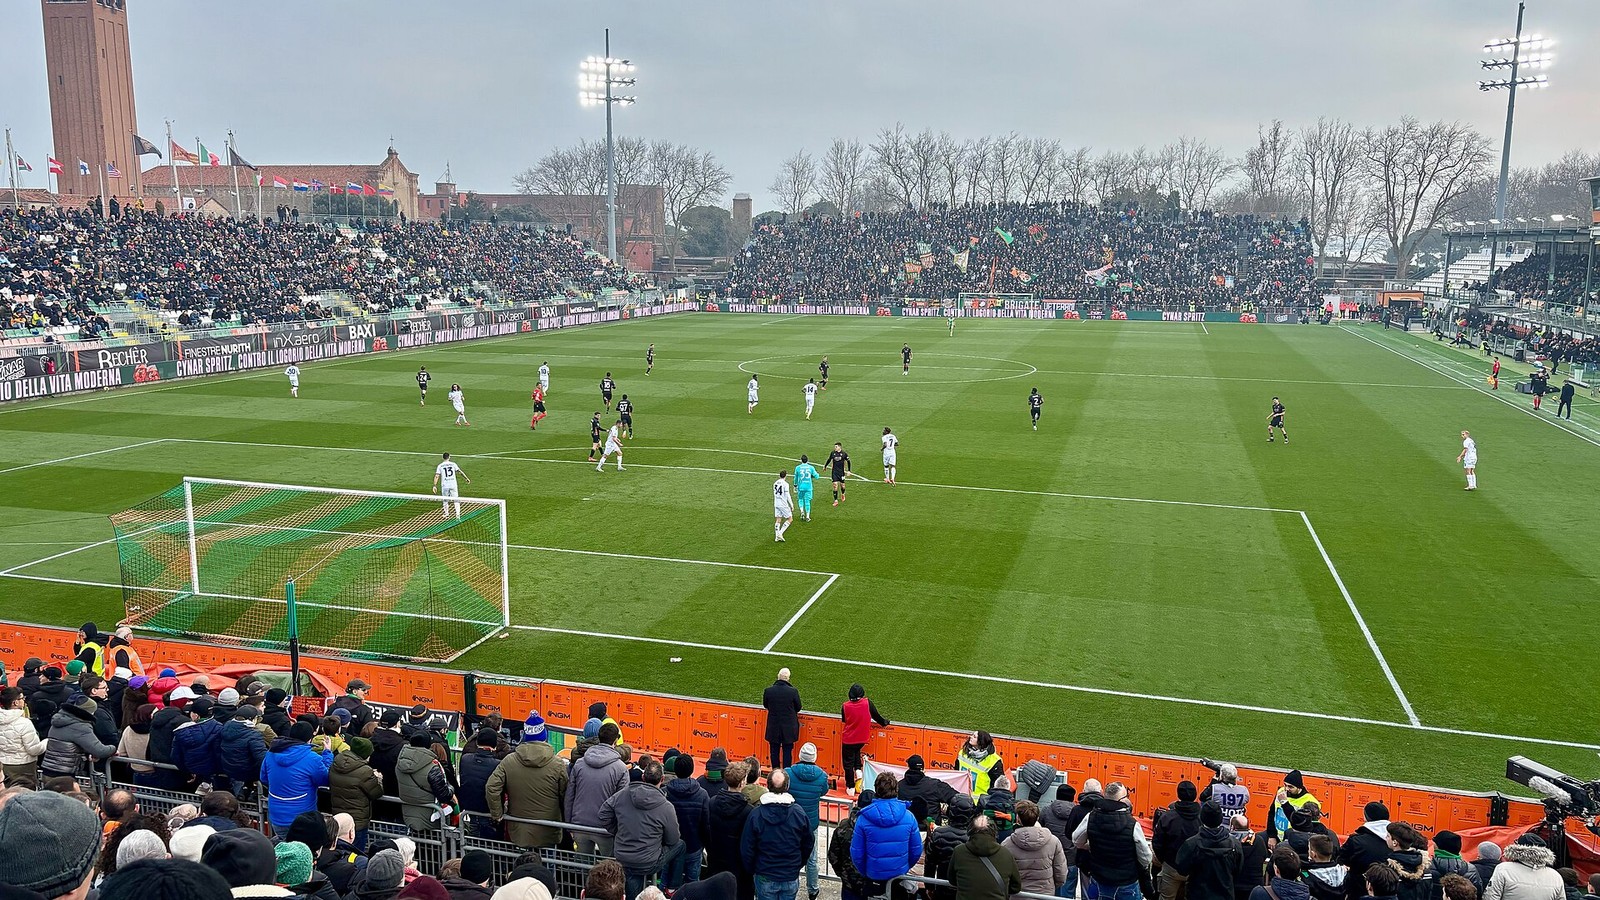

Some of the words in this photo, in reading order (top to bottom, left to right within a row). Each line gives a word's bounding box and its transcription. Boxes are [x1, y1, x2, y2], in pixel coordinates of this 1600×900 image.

[541, 307, 557, 318] BAXI
[1183, 312, 1205, 322] SPRITZ
[349, 324, 377, 339] BAXI
[176, 358, 203, 377] CYNAR
[238, 350, 266, 369] CONTRO
[268, 349, 275, 365] IL
[276, 345, 304, 363] LOGORIO
[305, 342, 324, 360] DELLA
[324, 341, 338, 357] VITA
[339, 338, 366, 356] MODERNA
[15, 376, 47, 398] DELLA
[49, 373, 72, 393] VITA
[75, 368, 122, 389] MODERNA
[443, 467, 454, 477] 13
[415, 695, 434, 704] NGM
[482, 703, 501, 712] NGM
[552, 711, 571, 719] NGM
[623, 721, 643, 729] NGM
[698, 730, 718, 739] NGM
[1220, 793, 1244, 806] 197
